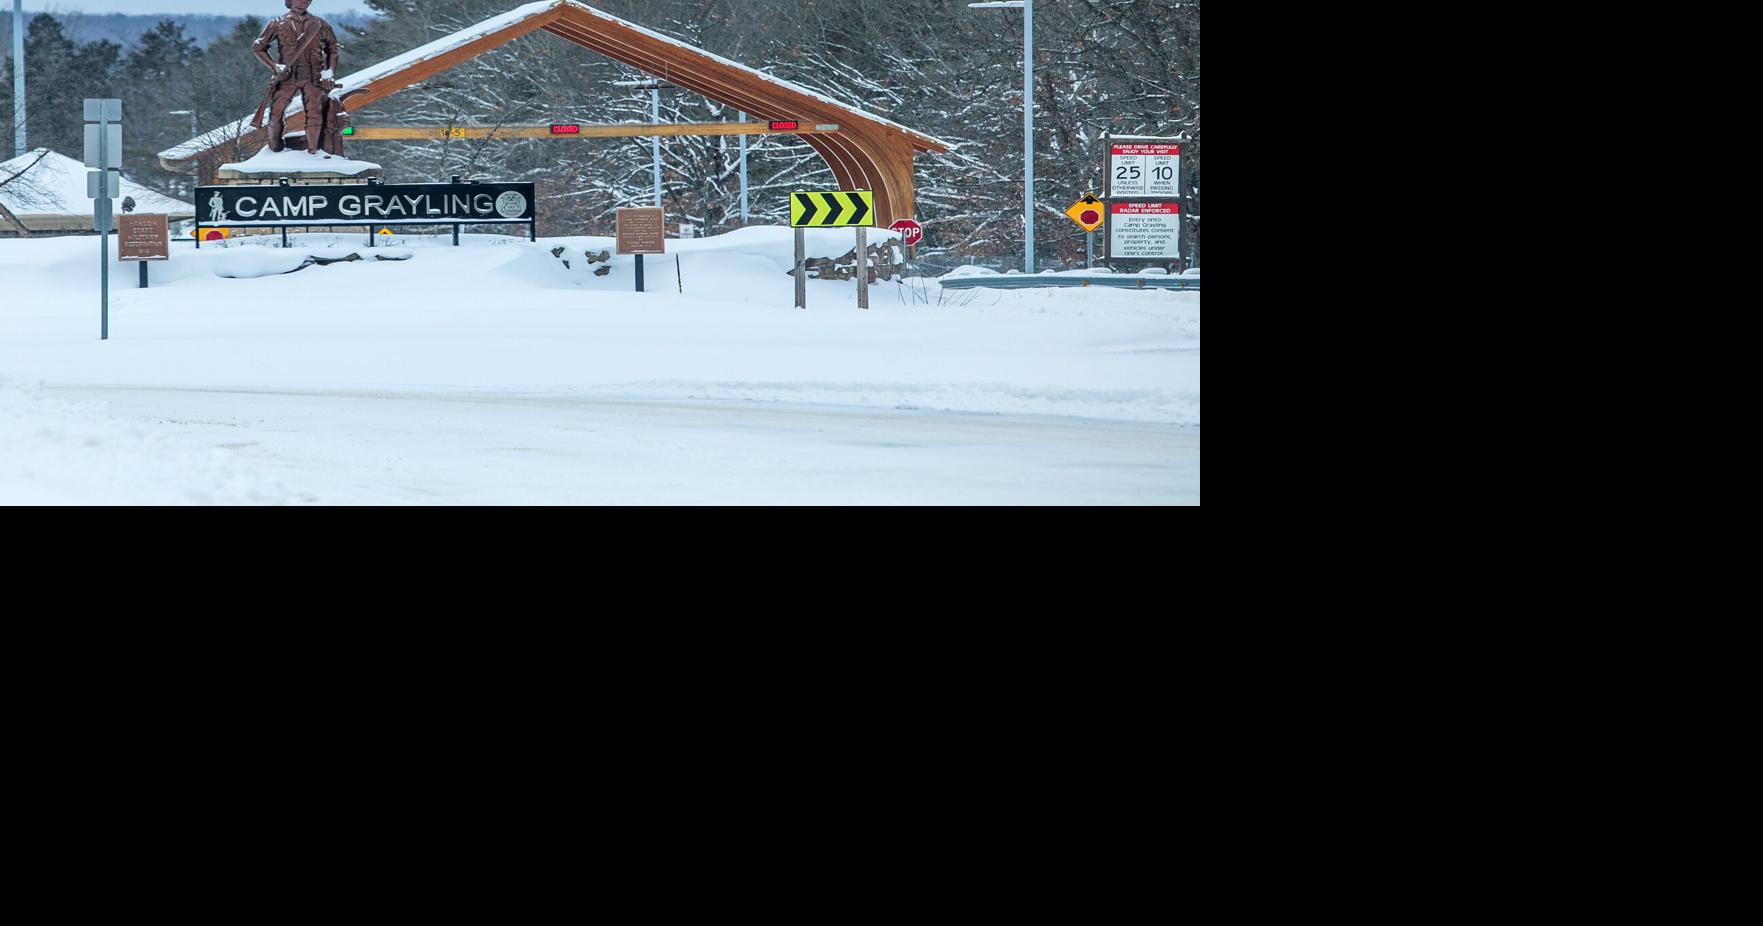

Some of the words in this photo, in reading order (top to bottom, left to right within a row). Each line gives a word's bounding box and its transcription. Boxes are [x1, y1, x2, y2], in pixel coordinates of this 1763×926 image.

[553, 125, 577, 133] CLOSED
[772, 122, 797, 130] CLOSED
[1116, 166, 1141, 180] 25
[1151, 166, 1173, 180] 10
[235, 195, 328, 217] CAMP
[338, 193, 494, 216] GRAYLING
